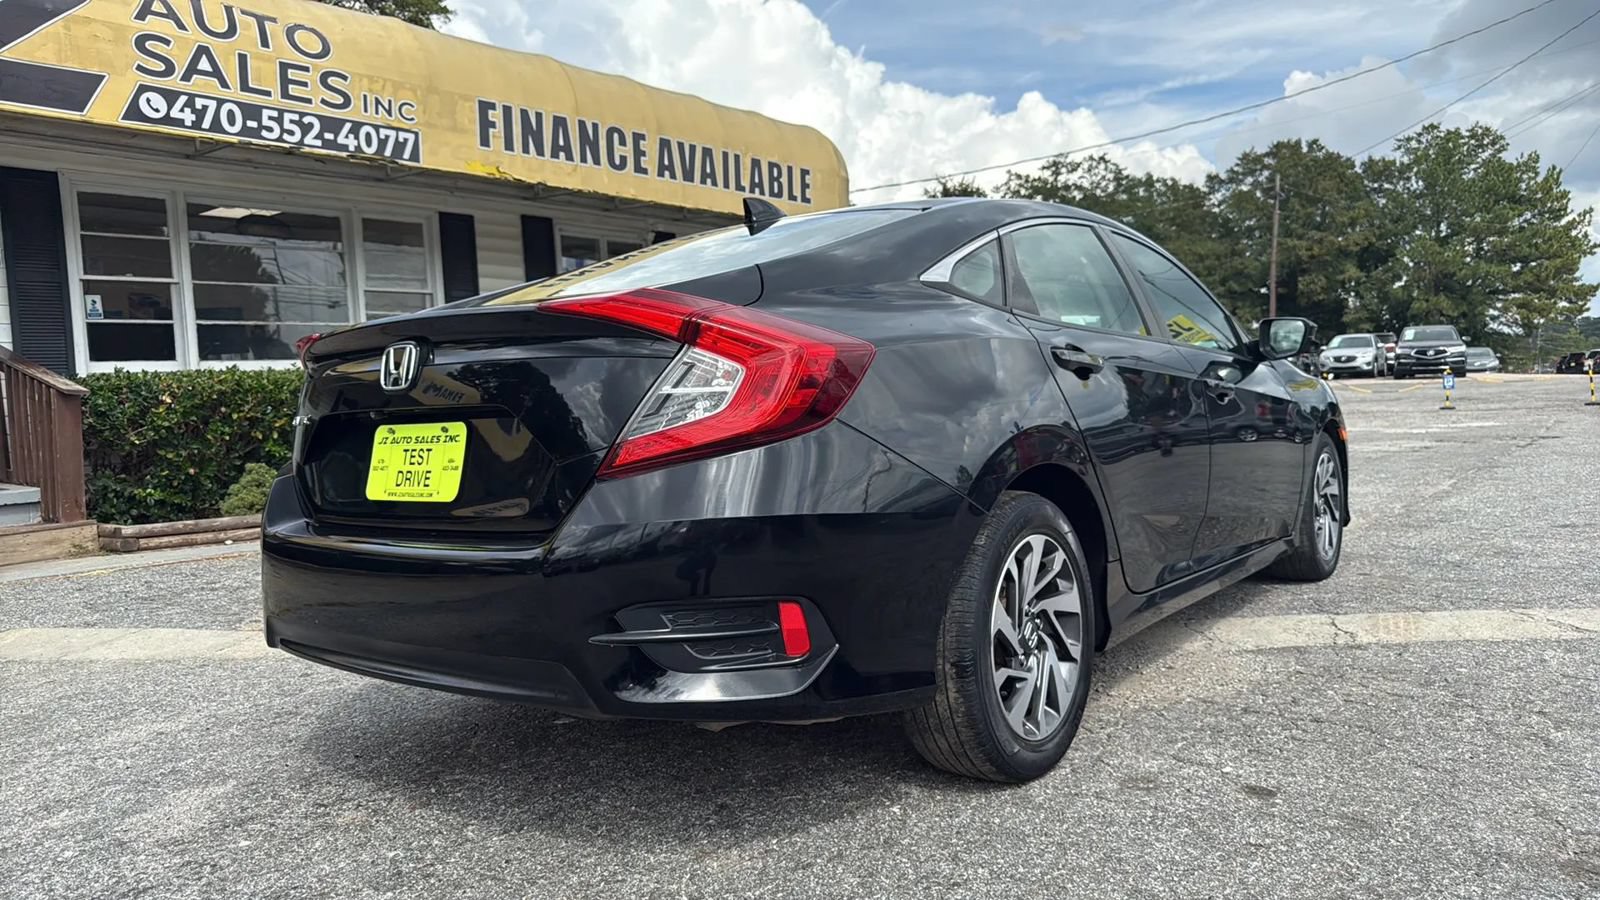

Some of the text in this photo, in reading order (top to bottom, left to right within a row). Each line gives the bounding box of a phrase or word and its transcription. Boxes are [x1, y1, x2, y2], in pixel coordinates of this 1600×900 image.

[133, 0, 332, 61] AUTO
[134, 32, 354, 111] SALES
[362, 93, 418, 123] INC
[169, 94, 416, 160] 470-552-4077
[477, 98, 812, 205] FINANCE AVAILABLE
[379, 436, 389, 445] JZ
[390, 436, 413, 445] AUTO
[413, 435, 441, 444] SALES
[403, 448, 432, 466] TEST
[395, 470, 432, 487] DRIVE
